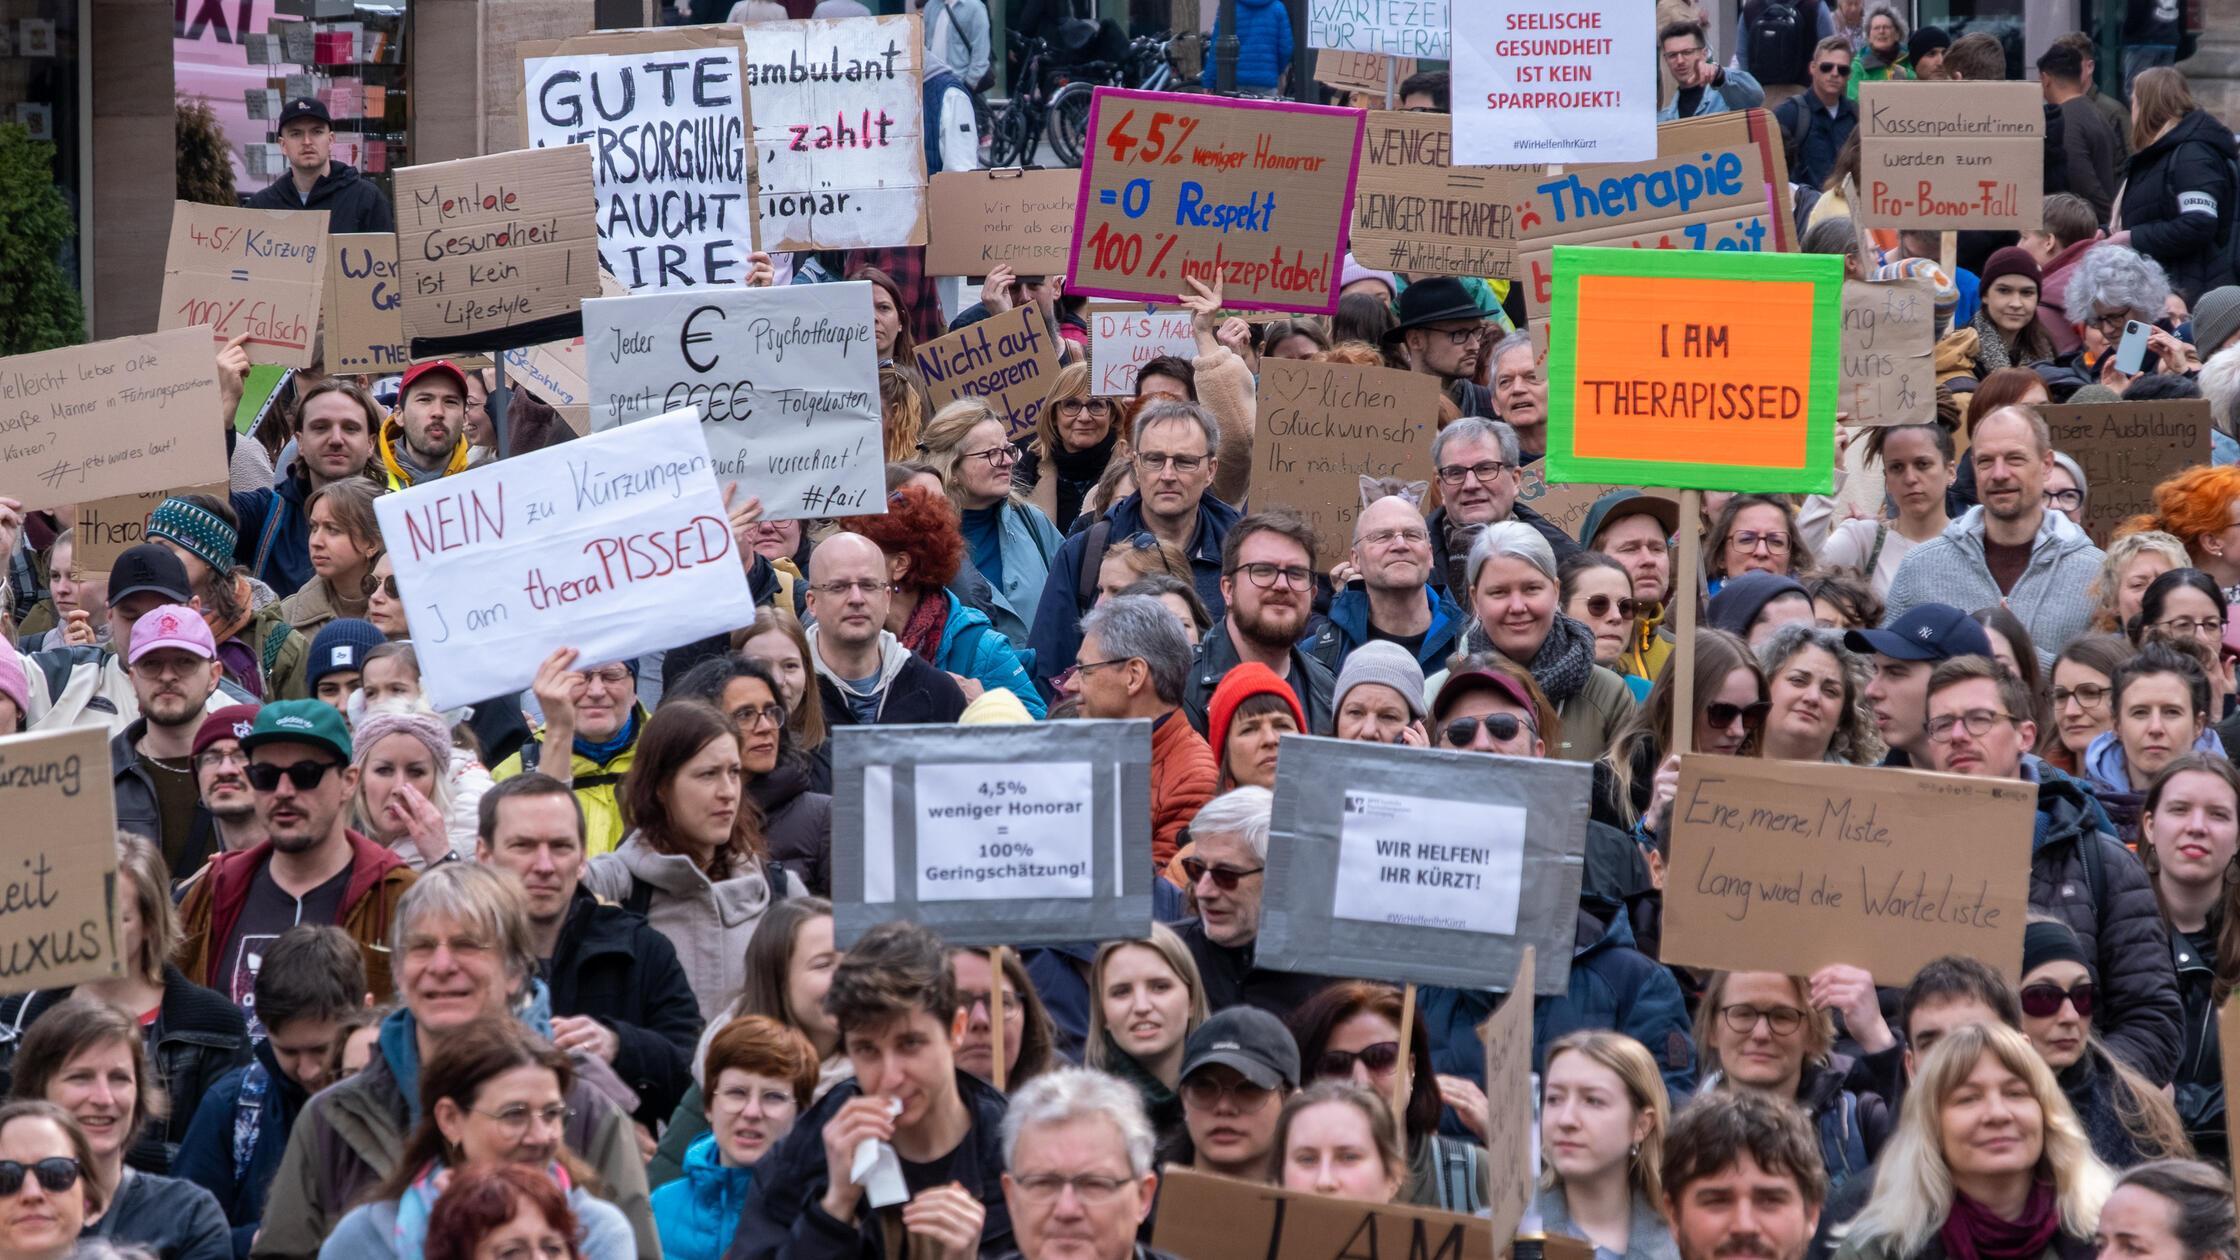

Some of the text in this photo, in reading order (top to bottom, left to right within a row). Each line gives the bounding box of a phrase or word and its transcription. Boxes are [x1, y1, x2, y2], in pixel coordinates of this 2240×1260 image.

[1311, 0, 1450, 28] WARTEZEI
[1506, 11, 1602, 31] SEELISCHE
[1310, 20, 1356, 49] FÜR
[1495, 37, 1613, 57] GESUNDHEIT
[747, 39, 902, 87] ambulant
[1516, 63, 1592, 83] IST KEIN
[539, 56, 732, 128] GUTE
[1487, 90, 1622, 110] SPARPROJEKT!
[788, 108, 894, 152] zahlt
[1106, 109, 1326, 173] 4,5% weniger Honorar
[1367, 127, 1451, 169] WENIGE
[1513, 138, 1597, 150] #WirHelfenIhrKürzt
[537, 114, 744, 187] RSORGUNG
[1883, 151, 1993, 168] werden zum
[415, 183, 520, 225] Mentale
[758, 181, 862, 220] ionär.
[1537, 152, 1743, 222] Therapie
[1872, 180, 2019, 217] Pro-Bono-Fall
[596, 190, 742, 239] AUCHT
[984, 200, 1011, 214] Wir
[1176, 182, 1276, 234] Respekt
[1359, 193, 1425, 232] WENIGER
[424, 219, 558, 261] Gesundheit
[984, 219, 1013, 232] mehr
[1024, 219, 1042, 233] als
[245, 228, 316, 264] Kürzung
[982, 244, 1070, 260] KLEMMBRET
[1389, 240, 1512, 276] #WirHelfenIhrKürzt
[416, 271, 445, 294] ist
[1180, 242, 1328, 294] inakzeptabel
[243, 301, 307, 343] falsch
[610, 304, 870, 373] Jeder € Psychotherapie
[1100, 315, 1151, 339] DAS
[917, 307, 1041, 387] Nicht auf
[1661, 324, 1729, 358] I AM
[0, 368, 68, 400] ielleicht
[1583, 380, 1801, 421] THERAPISSED
[51, 400, 97, 420] Männer
[106, 398, 116, 408] in
[609, 386, 659, 426] spart
[771, 388, 872, 427] Folgekosten,
[1268, 408, 1414, 443] Glückwunsch
[2046, 412, 2197, 448] nsere Ausbildung
[768, 436, 864, 475] verrechnet!
[1269, 442, 1296, 473] Ihr
[404, 454, 706, 562] NEIN zu Kürzungen
[802, 484, 867, 514] #fail
[467, 602, 508, 632] am
[523, 515, 730, 611] theraPISSED
[978, 781, 1027, 798] 4,5%
[928, 801, 1083, 818] weniger Honorar
[1685, 778, 1893, 848] Ene, mene, Miste,
[979, 843, 1034, 858] 100%
[1376, 839, 1490, 865] WIR HELFEN!
[925, 862, 1087, 883] Geringschätzung!
[1379, 865, 1481, 891] IHR KÜRZT!
[1697, 847, 1752, 922] Lang
[1759, 872, 1803, 905] wird
[1810, 874, 1843, 908] die
[0, 870, 121, 977] uxus!
[1386, 913, 1466, 929] #WirHelfenIhrKürzt
